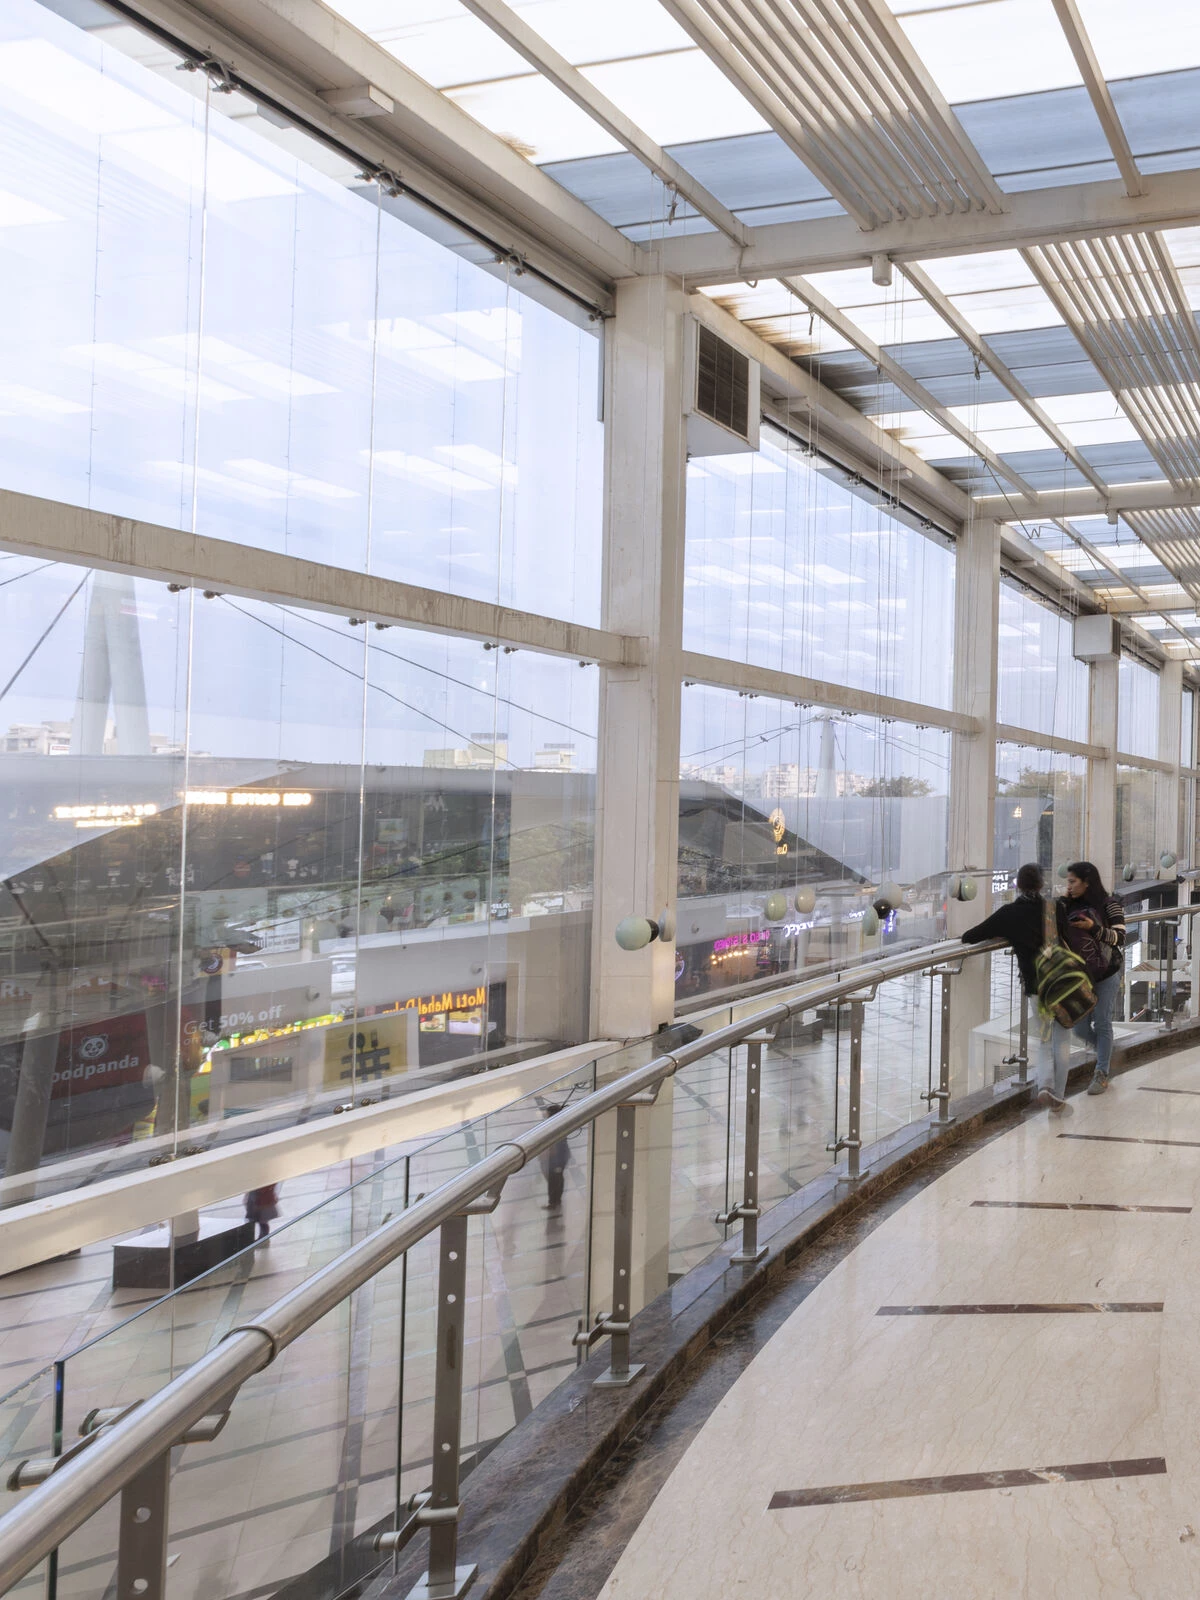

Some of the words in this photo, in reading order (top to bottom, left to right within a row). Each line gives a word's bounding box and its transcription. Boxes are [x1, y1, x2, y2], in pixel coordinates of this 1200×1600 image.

[184, 1018, 215, 1035] Get
[218, 1010, 254, 1029] 50%
[258, 1005, 286, 1021] off
[51, 1055, 140, 1083] oodpanda
